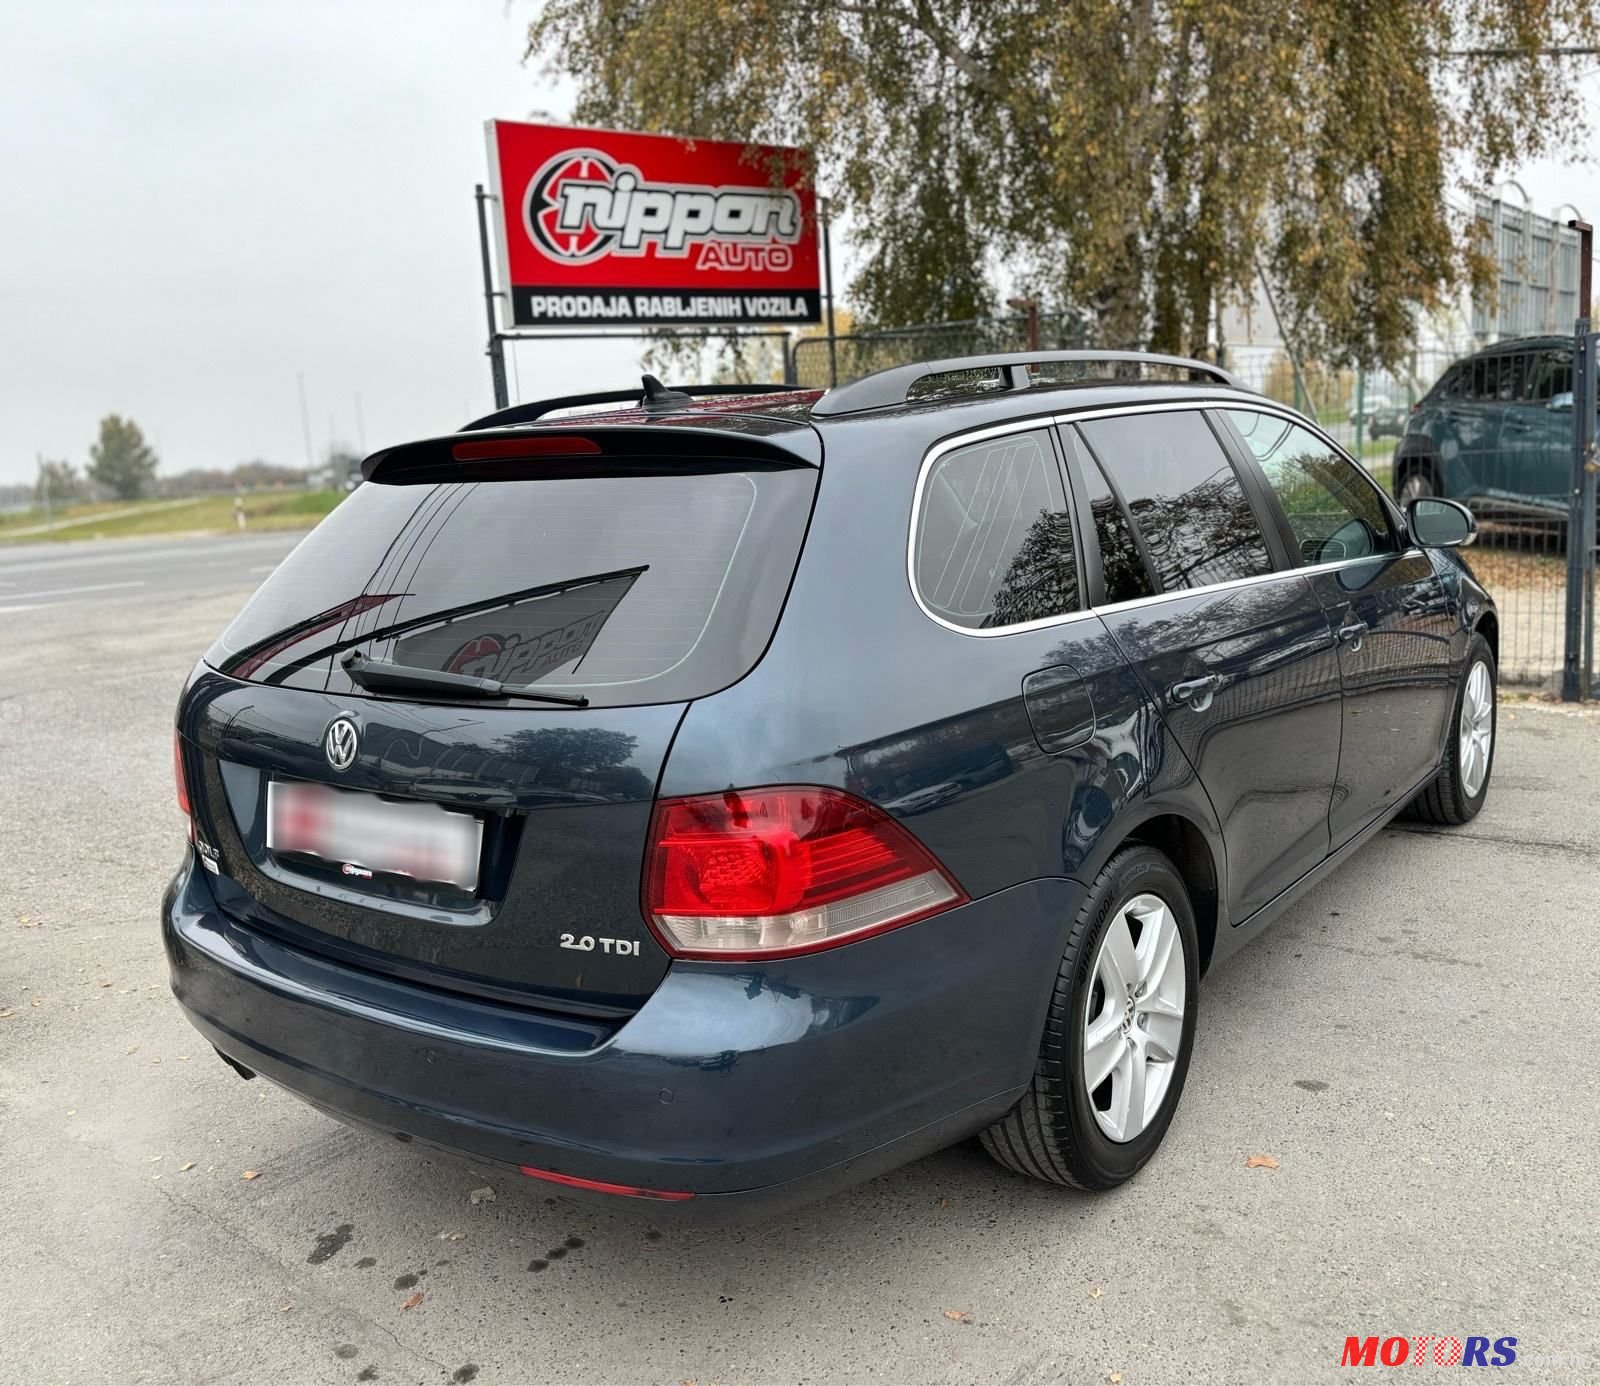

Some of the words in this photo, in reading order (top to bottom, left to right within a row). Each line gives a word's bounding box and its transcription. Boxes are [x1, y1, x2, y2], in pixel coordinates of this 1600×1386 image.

[559, 170, 800, 250] nippon
[695, 242, 794, 272] AUTO
[531, 295, 633, 318] PRODAJA
[636, 295, 744, 318] RABLJENIH
[745, 296, 808, 318] VOZILA
[599, 937, 641, 957] TDI
